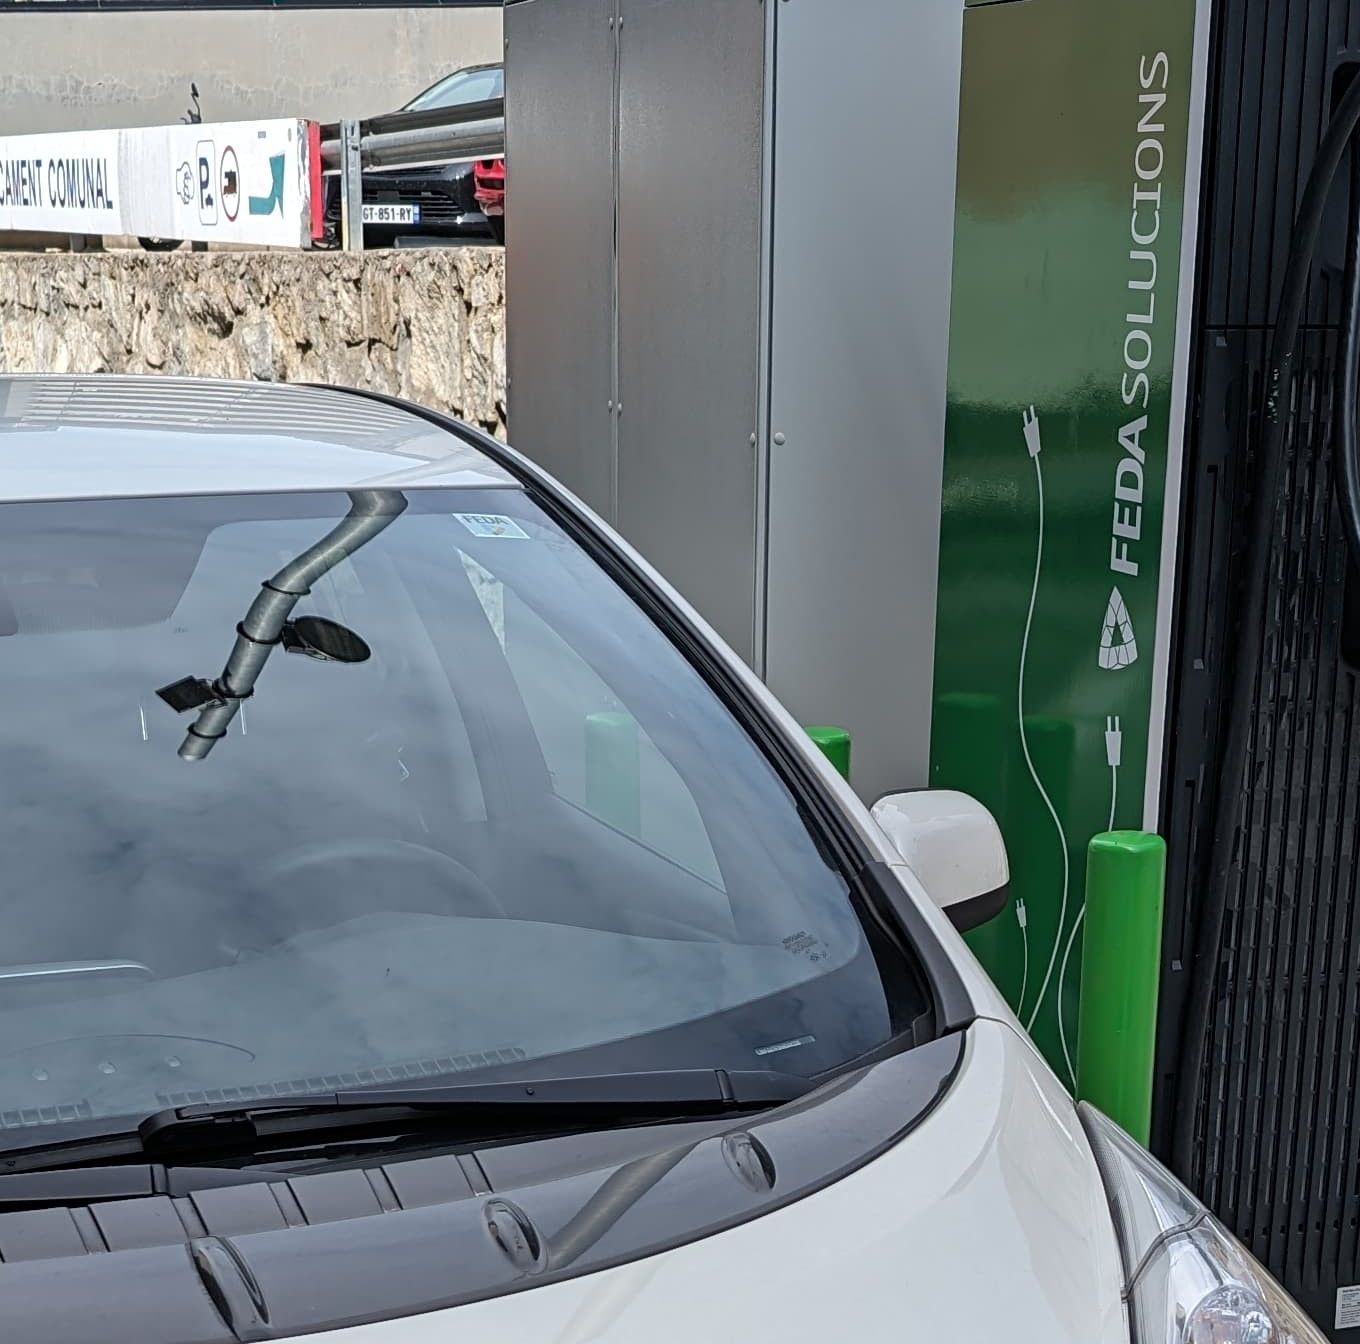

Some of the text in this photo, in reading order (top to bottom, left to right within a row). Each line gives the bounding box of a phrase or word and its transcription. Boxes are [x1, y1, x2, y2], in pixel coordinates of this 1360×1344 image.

[48, 158, 113, 209] COMUNAL
[363, 207, 412, 221] GT-851-RY
[1110, 51, 1169, 576] FEDA SOLUCIONS
